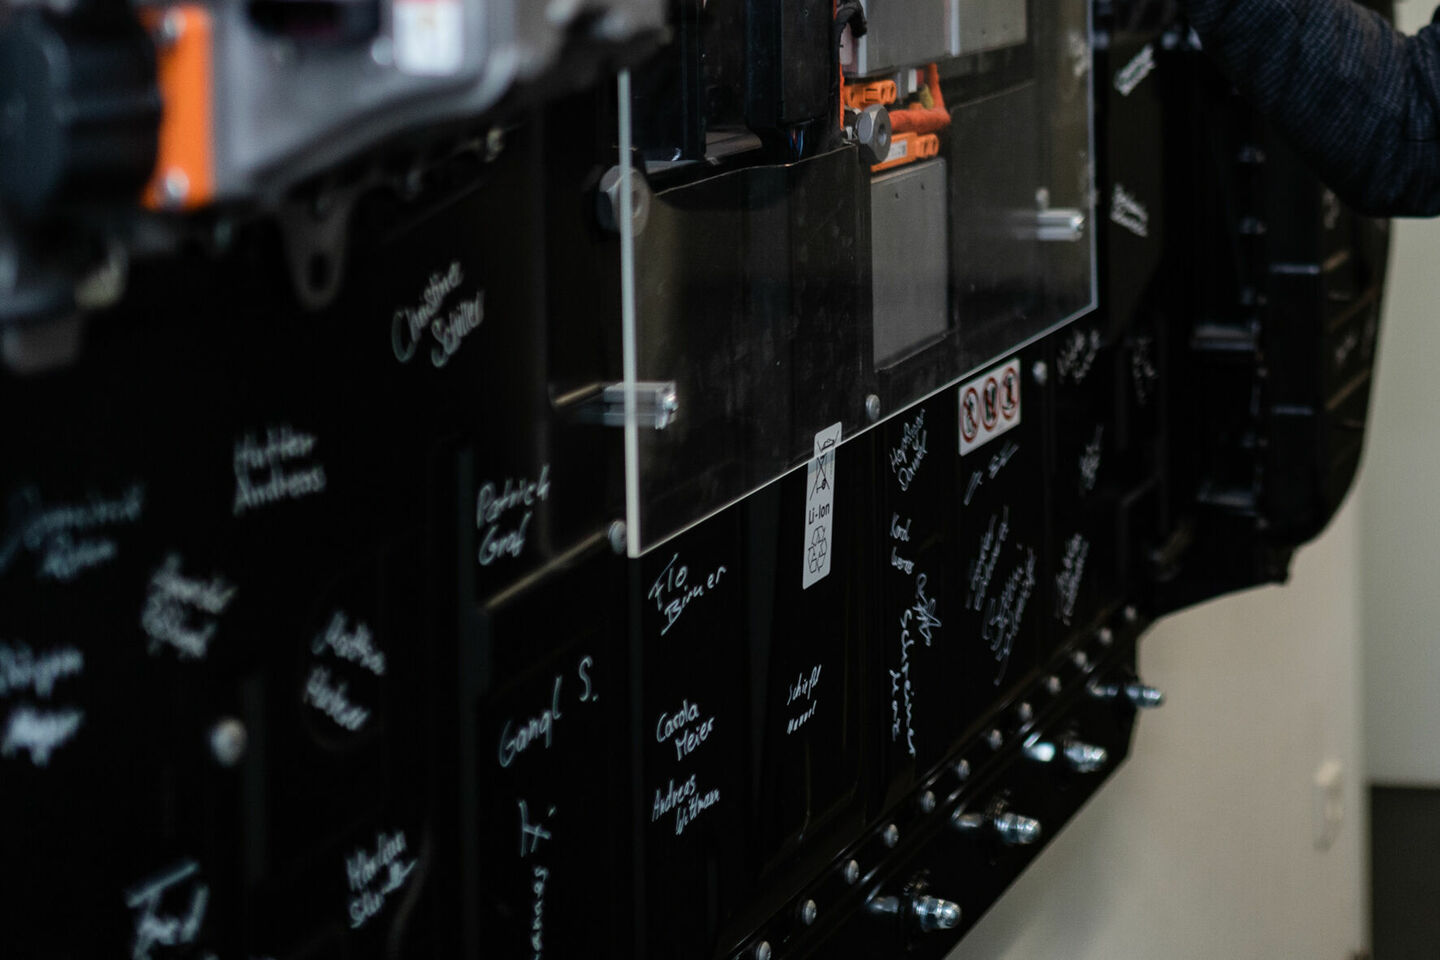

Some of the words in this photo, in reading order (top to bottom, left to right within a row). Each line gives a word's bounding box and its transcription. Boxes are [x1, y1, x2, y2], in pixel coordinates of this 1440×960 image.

[808, 502, 830, 525] Li-Ion
[656, 699, 700, 743] Carola
[675, 717, 715, 762] Meier
[652, 774, 696, 823] Andreas
